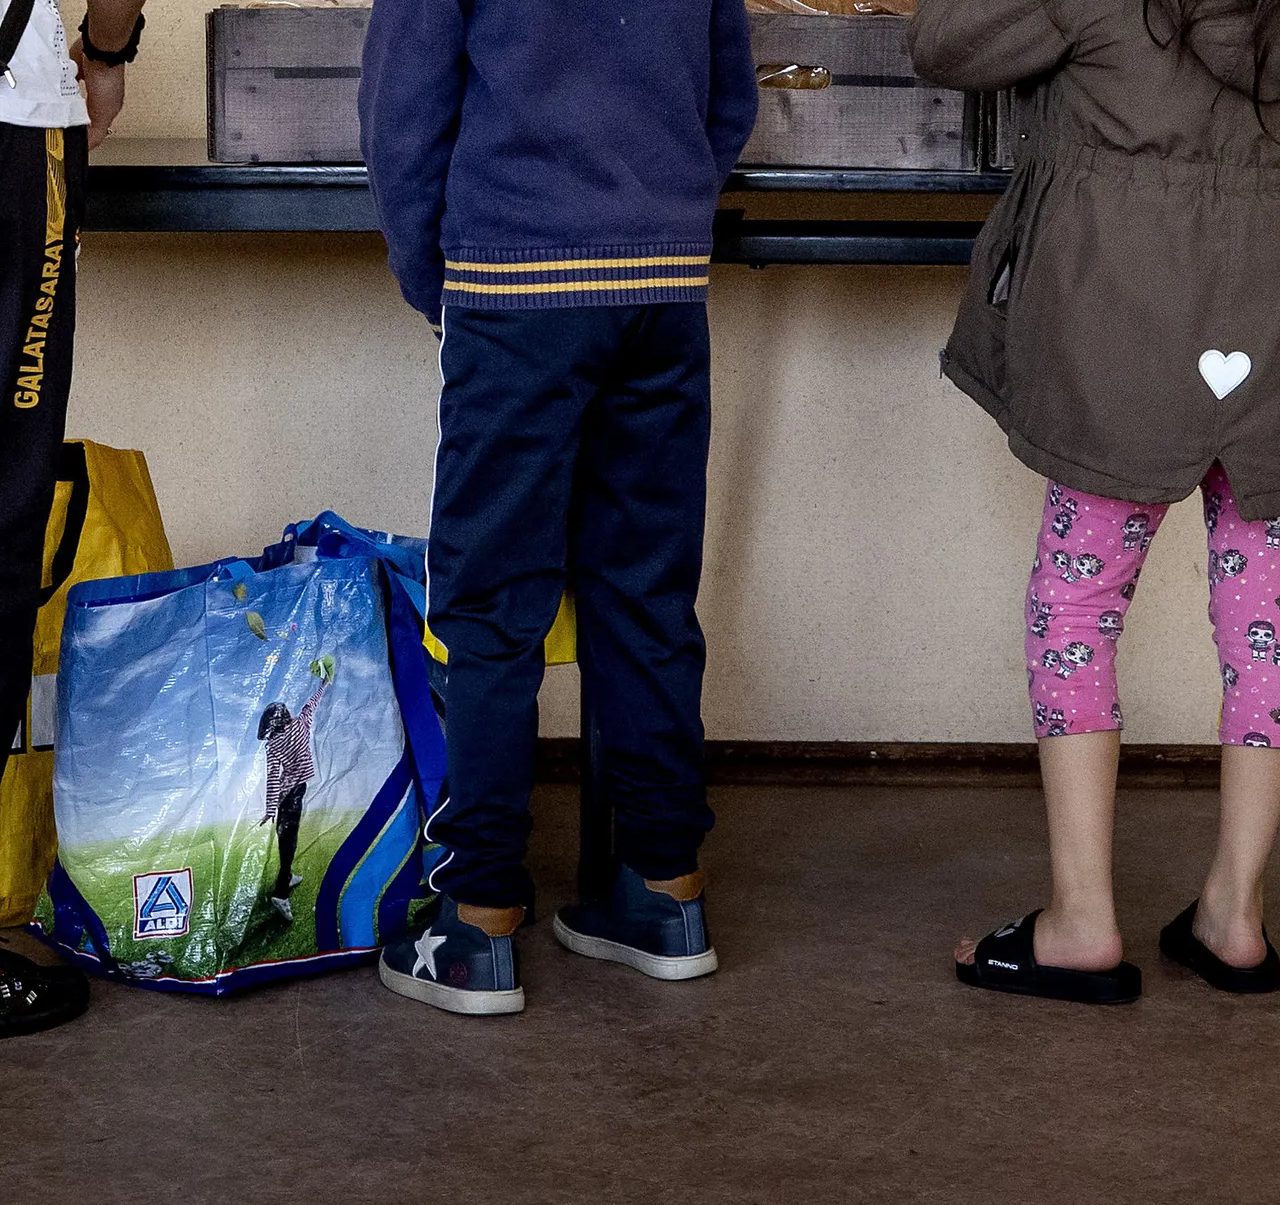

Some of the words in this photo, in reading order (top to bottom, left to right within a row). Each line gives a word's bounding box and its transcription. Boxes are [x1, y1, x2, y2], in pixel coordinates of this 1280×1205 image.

[13, 228, 64, 409] GALATASARAY
[143, 915, 184, 932] ALDI
[988, 959, 1019, 970] STANNO
